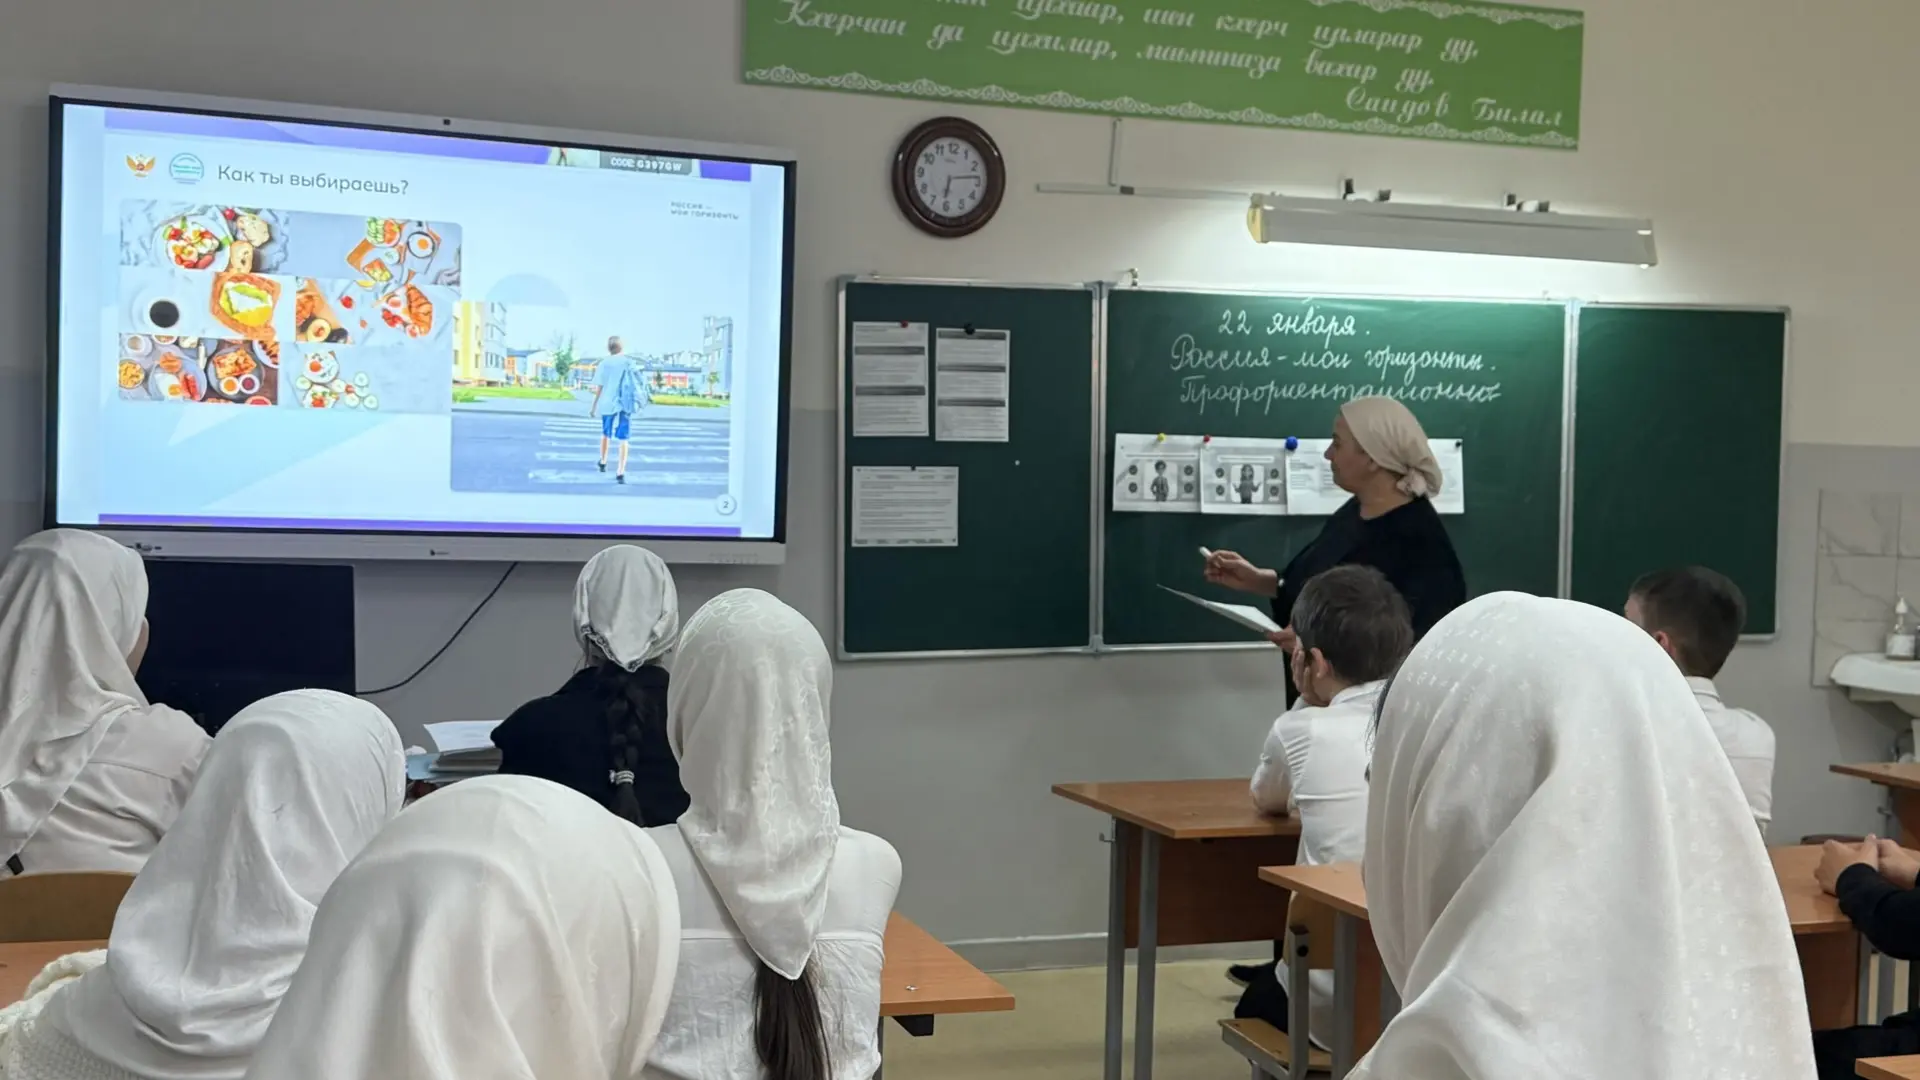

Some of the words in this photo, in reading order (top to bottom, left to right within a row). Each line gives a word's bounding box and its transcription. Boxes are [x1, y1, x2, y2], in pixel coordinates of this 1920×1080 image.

[926, 23, 965, 50] да
[1345, 86, 1449, 124] Саидов
[1472, 97, 1562, 127] Билал
[935, 143, 945, 156] 11
[948, 143, 960, 155] 12
[924, 152, 935, 165] 10
[971, 161, 979, 171] 2
[917, 167, 925, 178] 9
[217, 164, 255, 183] Как
[260, 171, 284, 185] ты
[289, 172, 409, 195] выбираешь?
[920, 183, 928, 195] 8
[968, 190, 976, 201] 4
[942, 201, 950, 212] 6
[958, 199, 965, 210] 5
[1219, 309, 1252, 335] 22
[722, 500, 730, 509] 2
